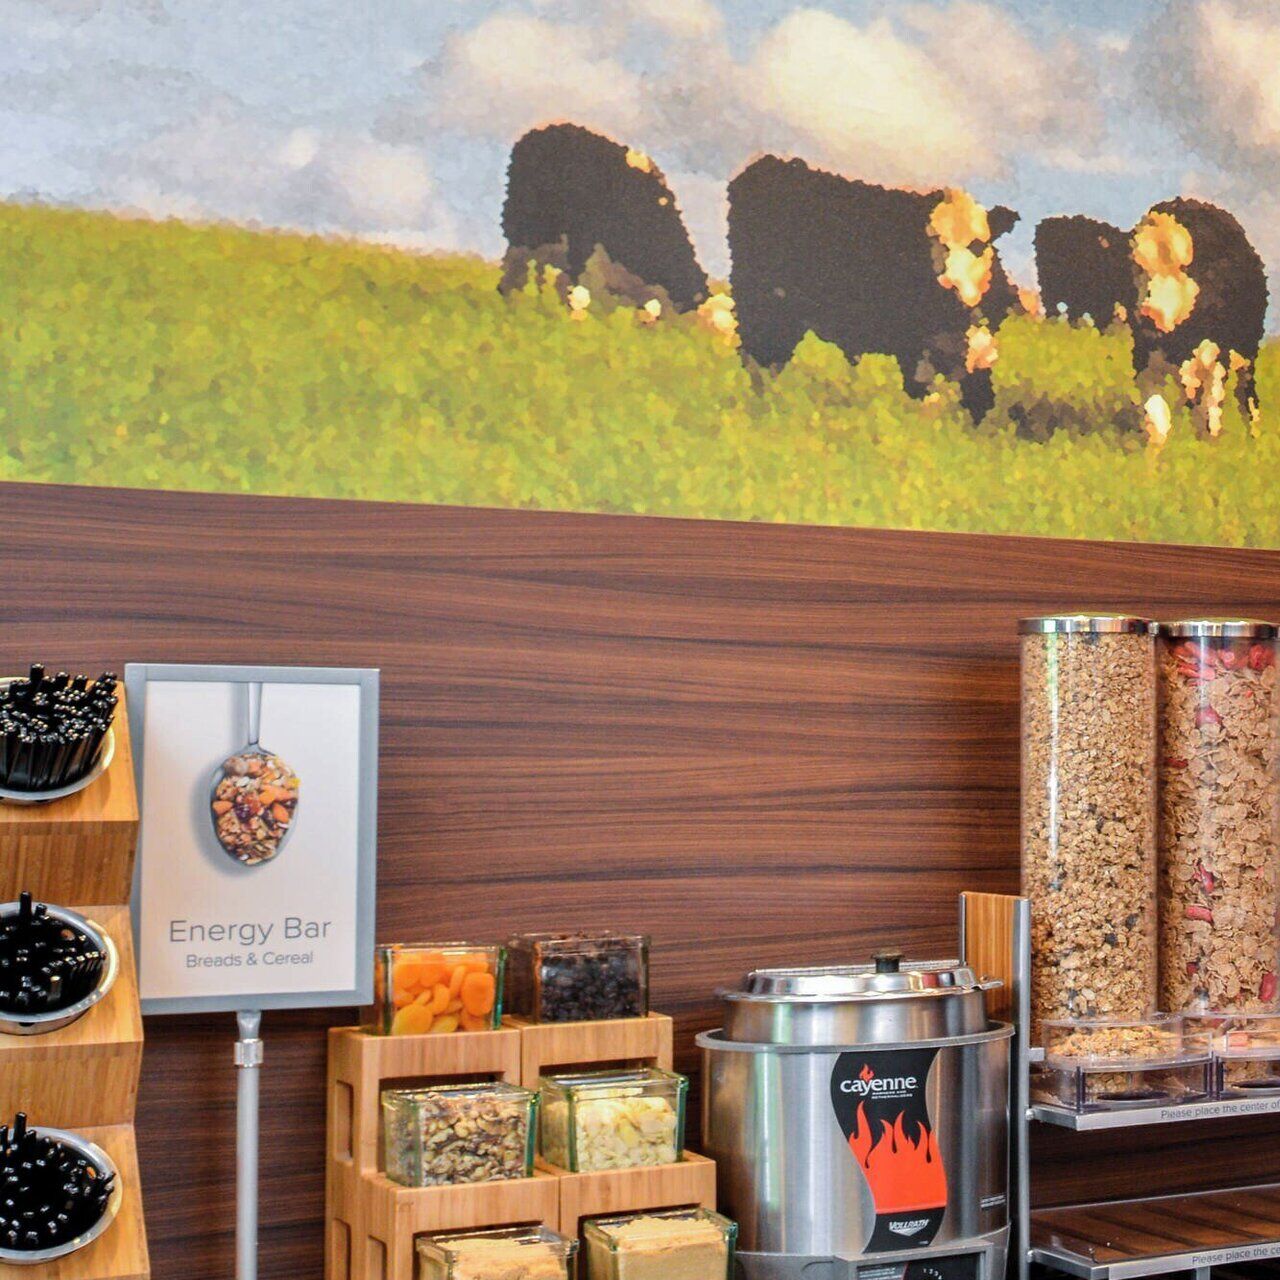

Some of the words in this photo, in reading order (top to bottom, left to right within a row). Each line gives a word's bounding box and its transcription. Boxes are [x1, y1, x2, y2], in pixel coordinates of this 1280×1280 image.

[169, 919, 274, 946] Energy
[284, 916, 332, 939] Bar
[186, 954, 242, 968] Breads
[246, 953, 258, 966] &
[262, 951, 313, 965] Cereal
[840, 1076, 917, 1096] cayenne
[1161, 1108, 1193, 1119] Please
[1195, 1105, 1220, 1117] place
[1222, 1103, 1238, 1113] the
[1240, 1101, 1268, 1112] center
[1271, 1099, 1280, 1109] of
[889, 1219, 929, 1231] VOLLRATH
[1192, 1253, 1223, 1265] Please
[1226, 1250, 1251, 1261] place
[1253, 1247, 1268, 1257] the
